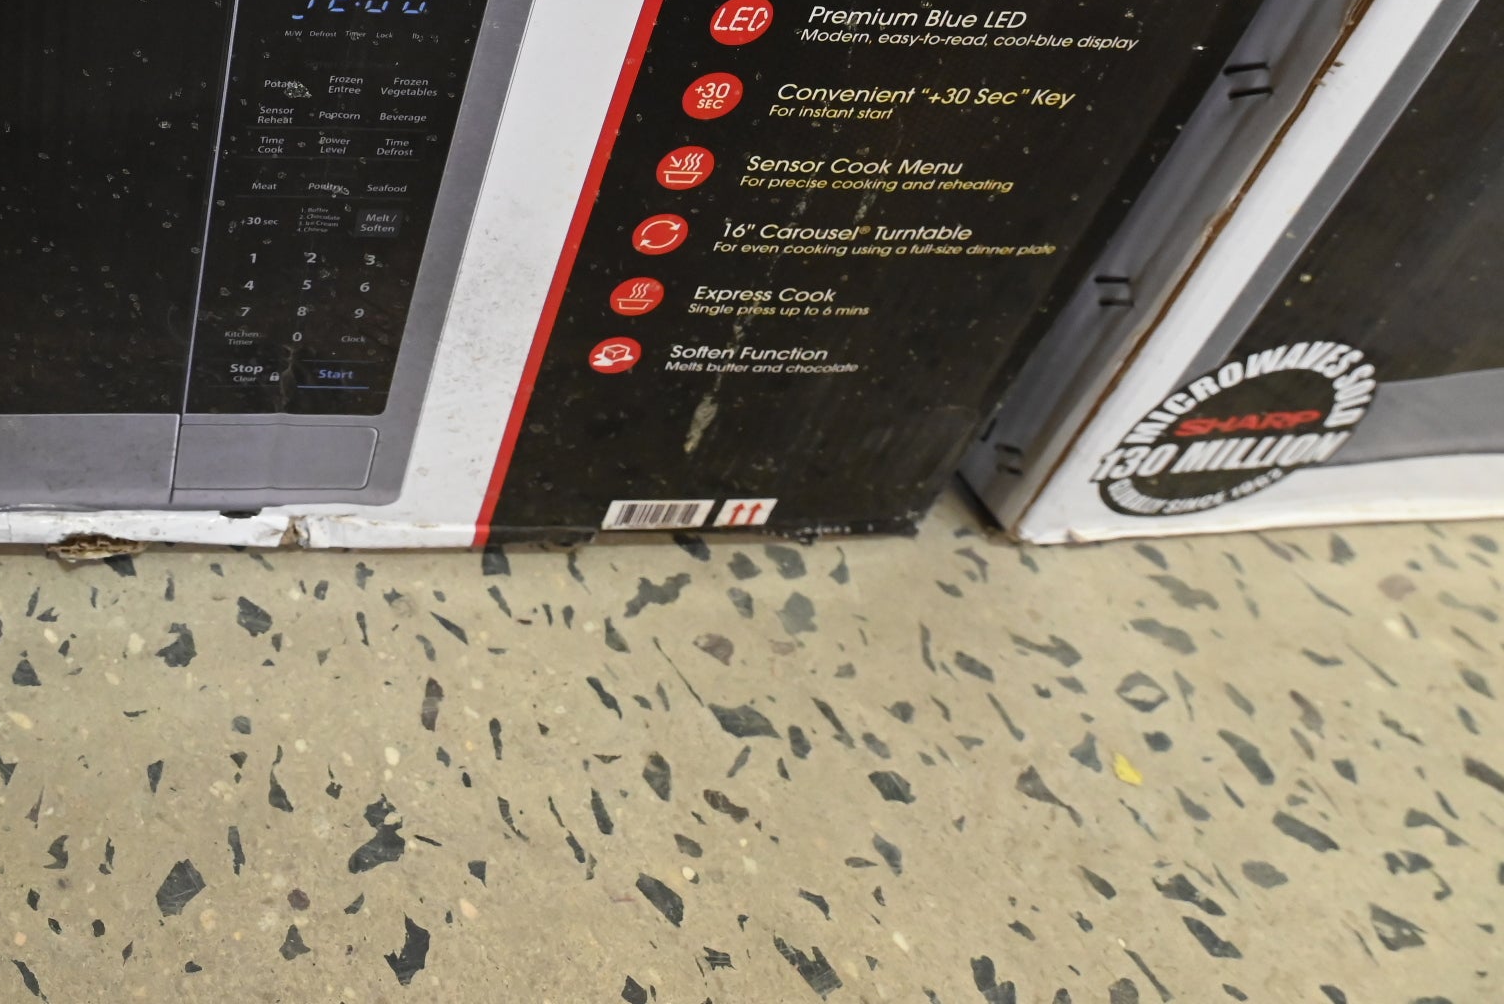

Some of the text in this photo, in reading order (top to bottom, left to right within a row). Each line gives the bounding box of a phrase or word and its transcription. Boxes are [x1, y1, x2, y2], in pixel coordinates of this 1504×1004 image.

[713, 6, 769, 32] LED
[807, 5, 1028, 30] Premium Blue LED
[309, 30, 337, 38] Defrost
[346, 30, 367, 38] Timer
[376, 31, 394, 39] Lock
[800, 29, 1139, 53] Modern, easy-to-read, cool-blue display
[329, 76, 364, 85] Frozen
[393, 77, 429, 86] Frozen
[328, 85, 362, 95] Entree
[380, 87, 438, 98] Vegetables
[694, 82, 731, 99] +30
[777, 83, 916, 105] Convenient
[1030, 89, 1076, 109] Key
[696, 99, 725, 110] SEC
[260, 106, 295, 115] Sensor
[769, 104, 894, 121] For instant start
[257, 115, 293, 125] Reheat
[319, 111, 361, 122] Popcorn
[379, 112, 428, 123] Beverage
[260, 136, 285, 145] Time
[319, 136, 351, 146] Power
[385, 138, 410, 147] Time
[257, 145, 284, 155] Cook
[319, 146, 346, 155] Level
[376, 147, 414, 157] Defrost
[746, 155, 963, 176] Sensor Cook Menu
[251, 182, 277, 191] Meat
[308, 182, 343, 193] Poultry
[367, 183, 408, 193] Seafood
[740, 175, 1014, 194] For precise cooking and reheating
[240, 216, 279, 226] +30 sec
[365, 213, 390, 223] Melt
[360, 223, 395, 233] Soften
[874, 226, 973, 241] Turntable
[713, 241, 1057, 258] For even cooking using a full-size dinner plate
[249, 253, 257, 263] 1
[306, 252, 317, 263] 2
[365, 254, 376, 265] 3
[244, 280, 254, 291] 4
[301, 280, 312, 291] 5
[360, 281, 370, 293] 6
[693, 286, 836, 303] Express Cook
[240, 306, 250, 317] 7
[296, 306, 307, 317] 8
[354, 308, 365, 319] 9
[687, 303, 870, 317] Single press up to 6 mins
[224, 330, 259, 339] Kitchen
[292, 332, 302, 342] 0
[341, 335, 366, 343] Clock
[228, 338, 253, 346] Timer
[670, 345, 829, 361] Soften Function
[230, 363, 263, 375] Stop
[664, 361, 859, 374] Melts butter and chocolate
[233, 374, 257, 383] Clear
[318, 369, 353, 380] Start
[1124, 341, 1377, 445] MICROWAVES SOLD
[1173, 409, 1322, 437] SHARP
[1090, 430, 1351, 482] 130 MILLION
